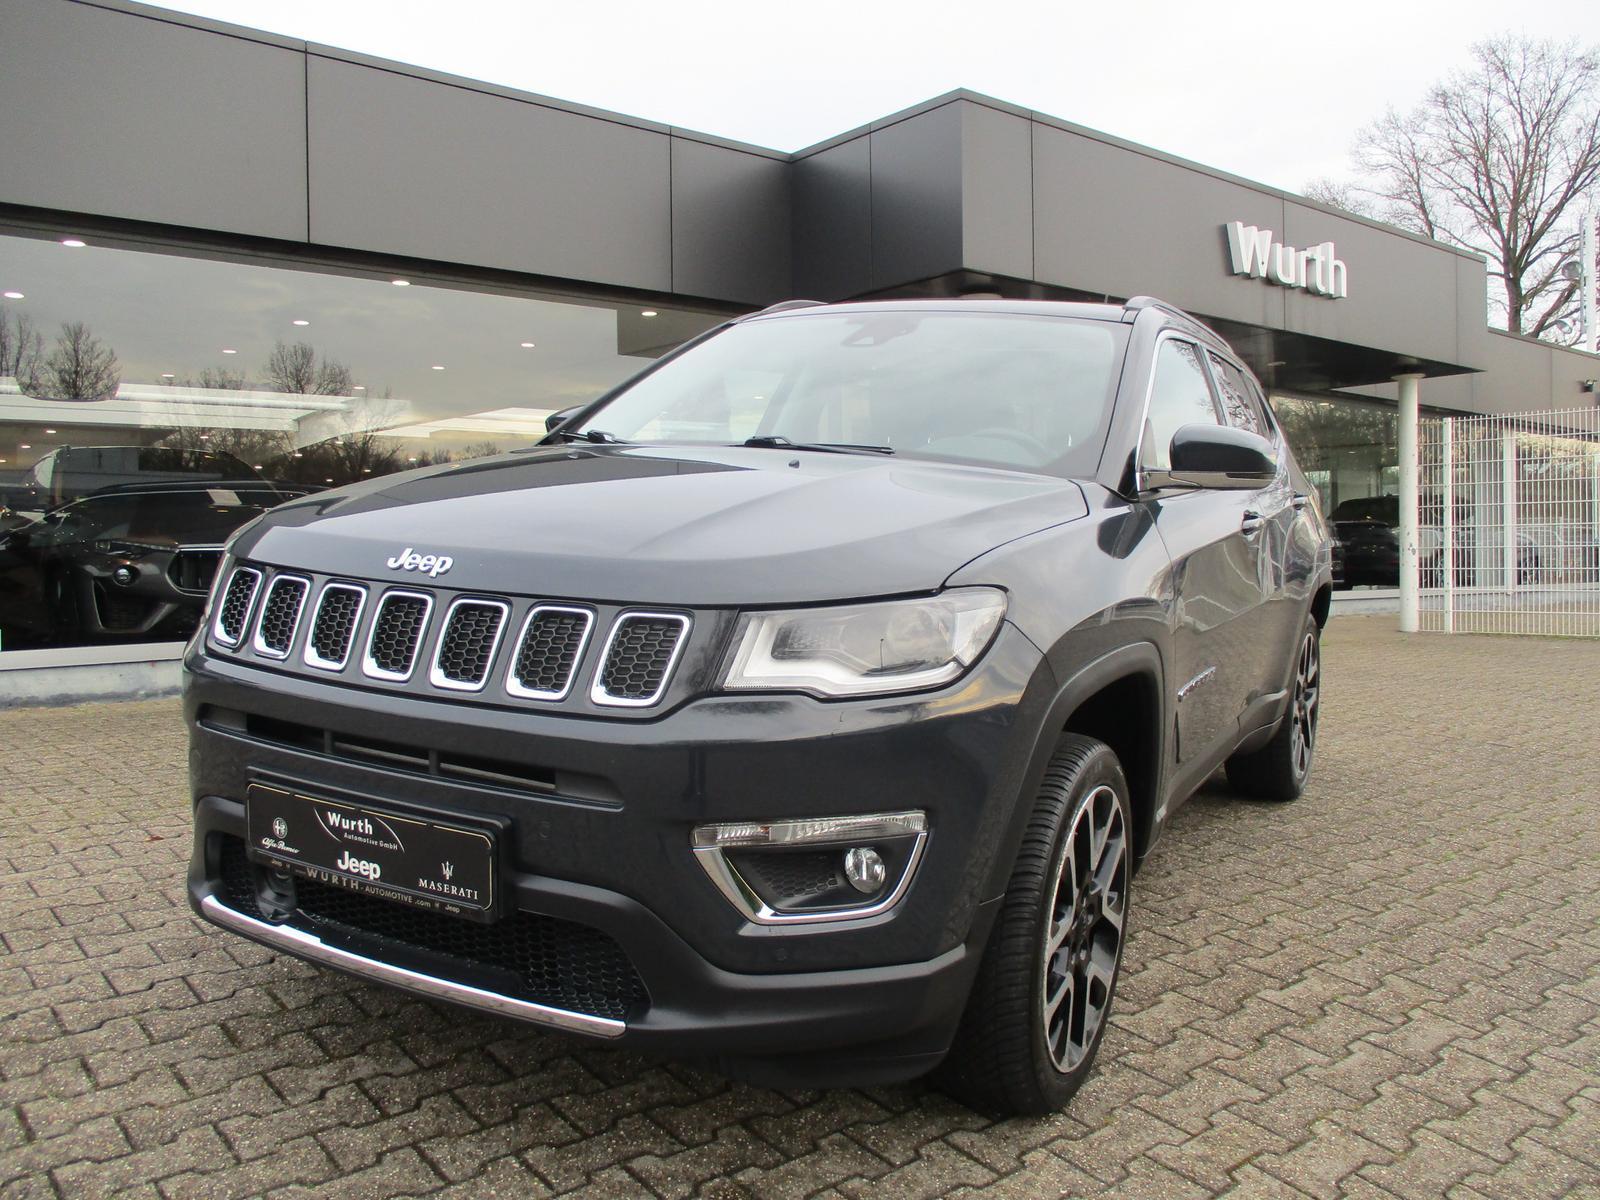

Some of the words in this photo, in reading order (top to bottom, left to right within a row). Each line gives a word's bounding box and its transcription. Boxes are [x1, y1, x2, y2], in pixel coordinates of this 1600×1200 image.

[1225, 221, 1347, 299] Wurth
[387, 548, 454, 578] Jeep
[327, 811, 373, 835] Wurth
[343, 832, 378, 846] Automotive
[379, 840, 398, 851] GmbH
[337, 850, 382, 880] Jeep
[418, 878, 479, 900] MASERATI
